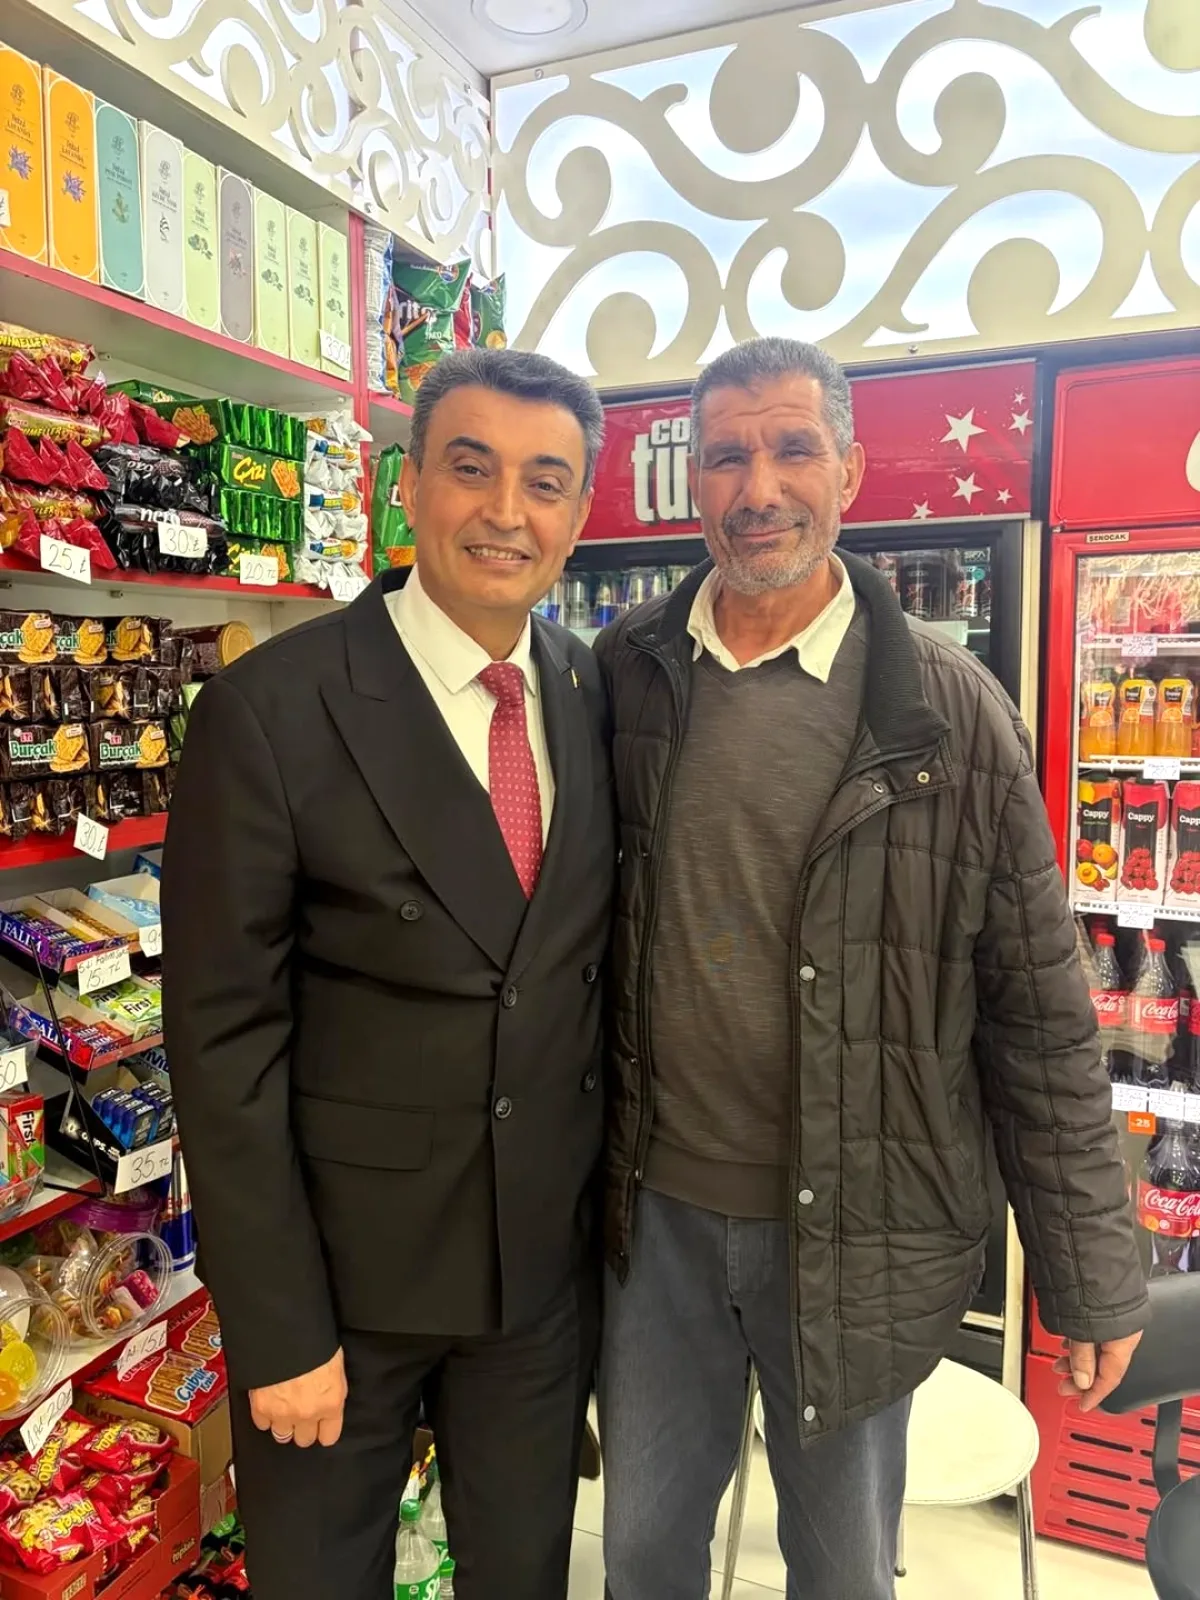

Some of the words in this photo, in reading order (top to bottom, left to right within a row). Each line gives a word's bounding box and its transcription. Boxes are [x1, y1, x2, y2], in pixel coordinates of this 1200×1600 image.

[650, 417, 691, 446] co
[630, 433, 701, 522] tu
[9, 739, 57, 760] Burçak
[100, 742, 142, 761] Burçak
[1083, 809, 1110, 820] Cappy
[1128, 811, 1155, 823] Cappy
[1179, 814, 1200, 827] Capp
[122, 996, 152, 1015] First
[22, 1110, 37, 1144] First
[38, 1439, 62, 1484] opkek
